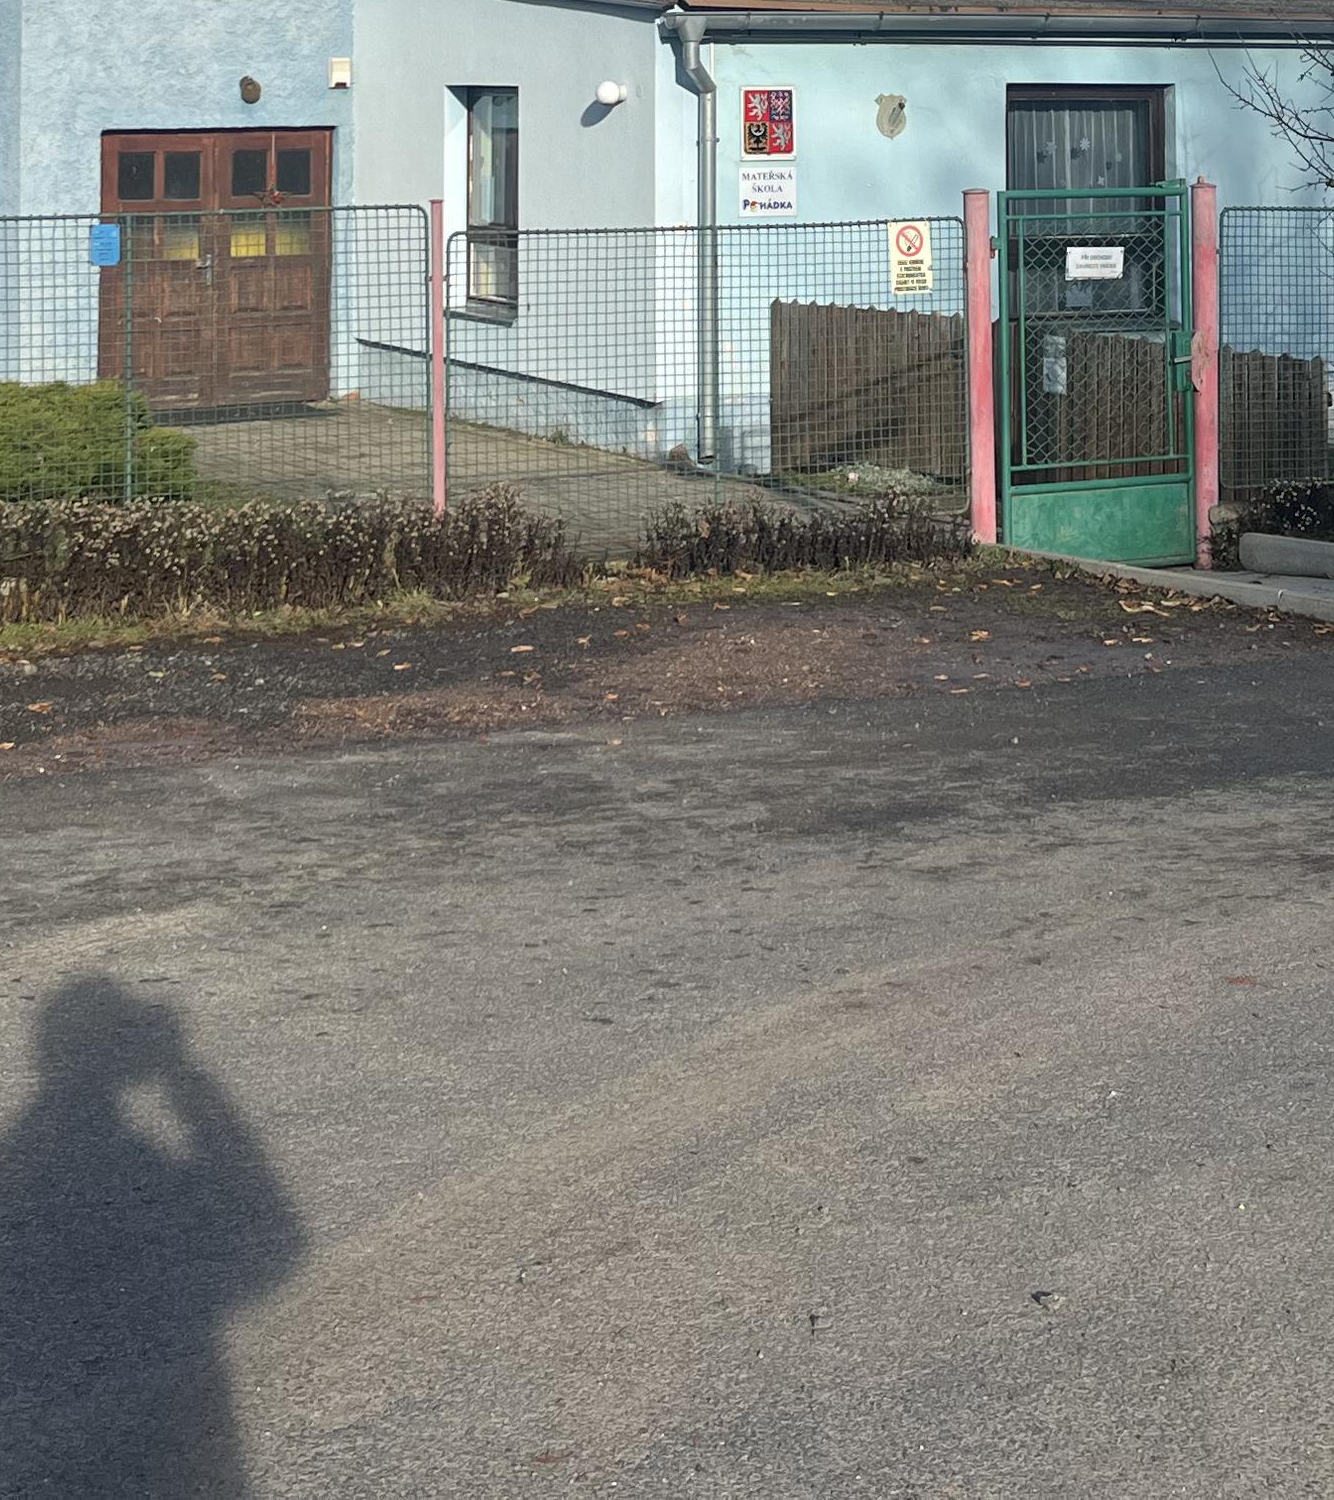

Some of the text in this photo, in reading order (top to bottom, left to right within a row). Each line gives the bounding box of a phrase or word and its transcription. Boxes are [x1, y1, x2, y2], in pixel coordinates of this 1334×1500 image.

[742, 170, 793, 181] MATEŘSKÁ
[751, 182, 783, 193] ŠKOLA
[742, 198, 793, 211] PHÁDKA
